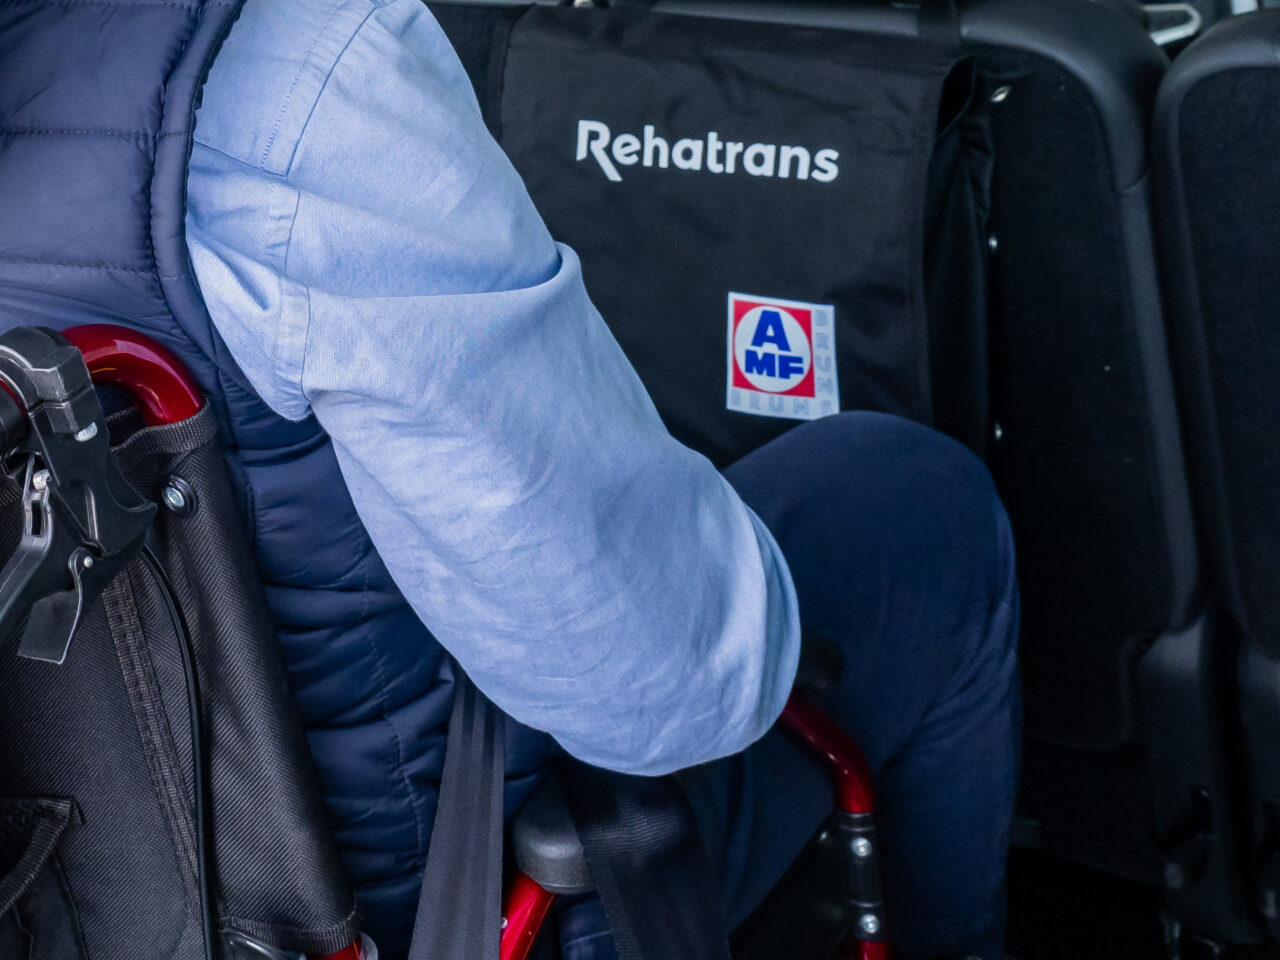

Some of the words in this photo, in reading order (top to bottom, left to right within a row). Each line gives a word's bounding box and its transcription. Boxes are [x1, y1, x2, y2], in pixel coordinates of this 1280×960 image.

[576, 119, 840, 182] Rehatrans
[750, 309, 792, 352] A
[744, 349, 805, 380] MF
